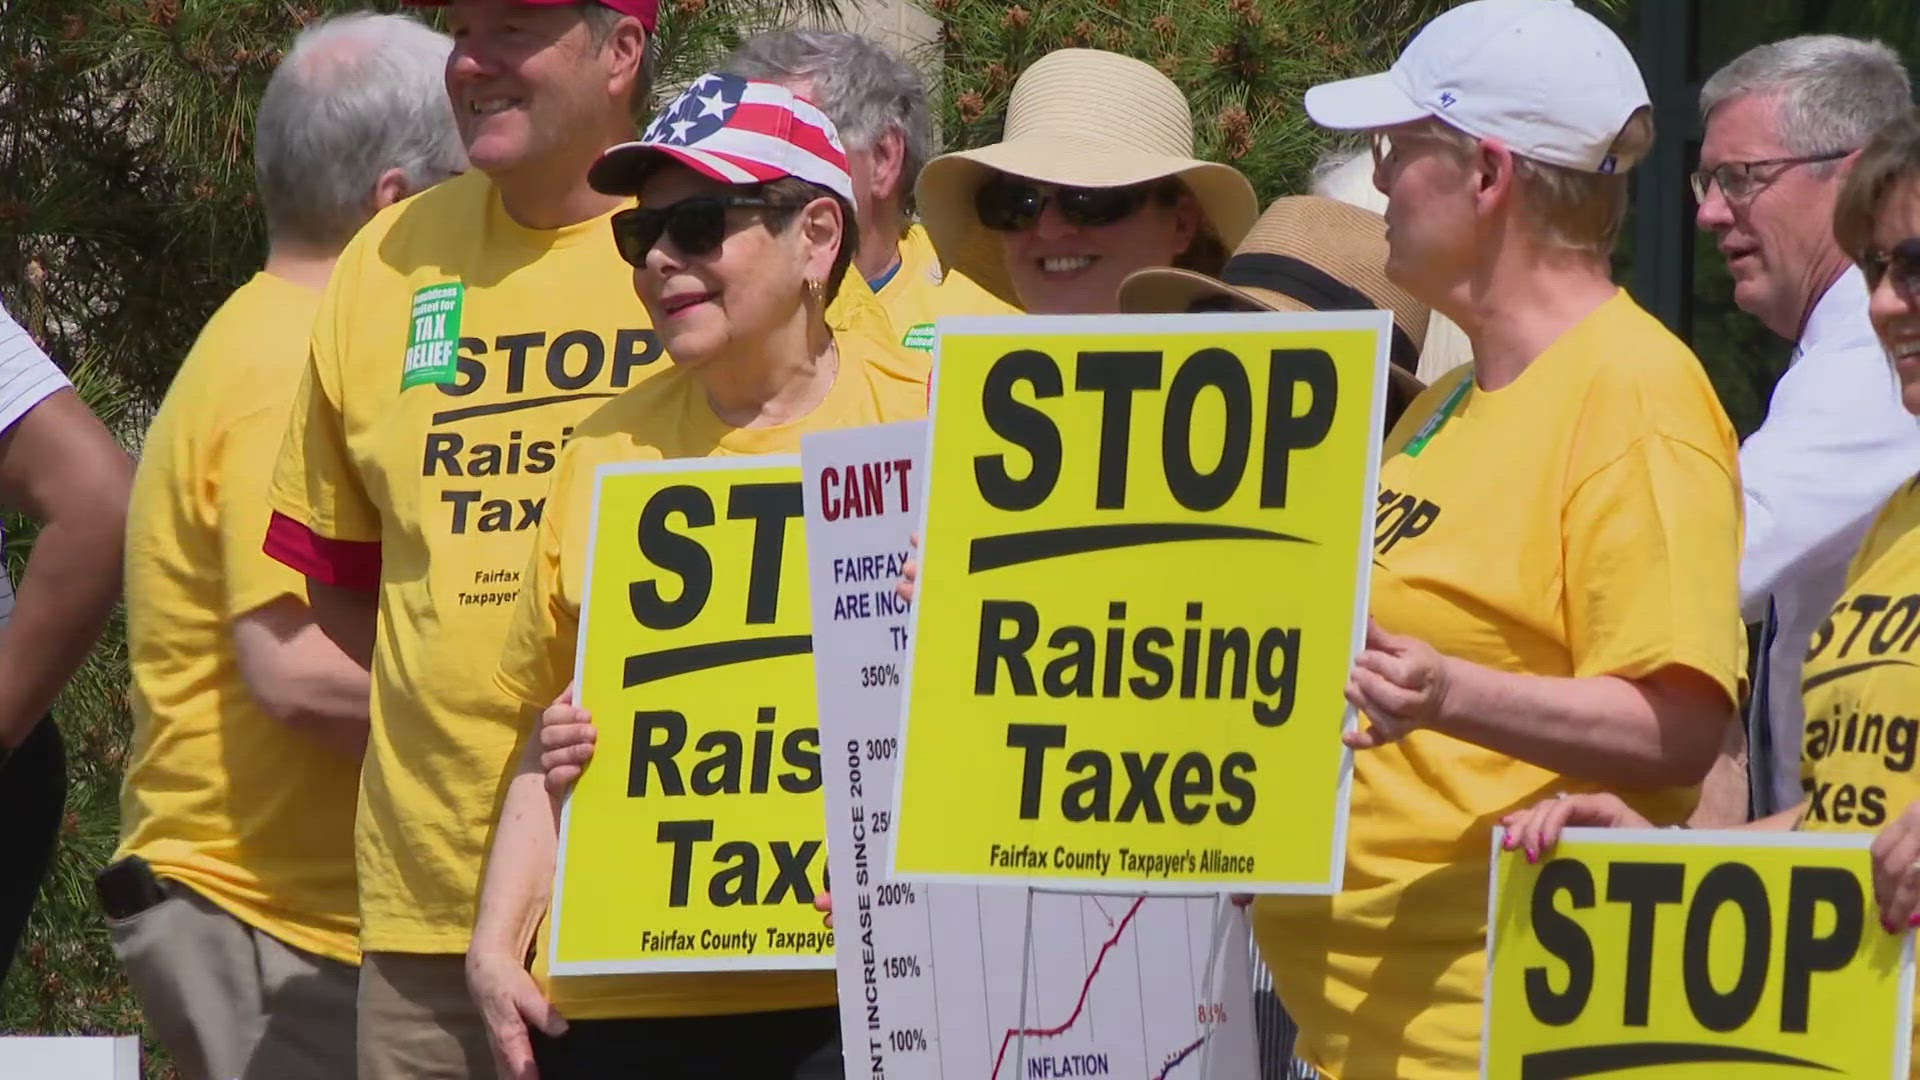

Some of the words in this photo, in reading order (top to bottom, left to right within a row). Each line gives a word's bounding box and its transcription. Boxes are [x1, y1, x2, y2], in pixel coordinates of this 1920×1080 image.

[415, 313, 446, 343] TAX
[404, 340, 453, 373] RELIEF
[436, 329, 664, 397] STOP
[974, 347, 1338, 512] STOP
[820, 459, 912, 522] CAN'T
[441, 490, 546, 534] Tax
[475, 569, 520, 584] Fairfax
[629, 484, 805, 631] ST
[834, 551, 909, 583] FAIRFAX
[834, 594, 871, 621] ARE
[875, 590, 911, 617] INC
[861, 663, 900, 687] 350%
[975, 600, 1301, 728] Raising
[626, 706, 823, 798] Rais
[847, 740, 862, 798] 2000
[1006, 724, 1258, 826] Taxes
[872, 809, 891, 834] 25
[656, 820, 831, 909] Tax
[852, 805, 868, 887] SINCE
[990, 844, 1048, 869] Fairfax
[1053, 846, 1111, 876] County
[1119, 847, 1196, 878] Taxpayer's
[1200, 849, 1255, 874] Alliance
[877, 882, 915, 906] 200%
[641, 930, 695, 952] Fairfax
[701, 929, 758, 954] County
[766, 927, 835, 953] Taxpaye
[1524, 857, 1864, 1034] STOP
[858, 893, 881, 1030] INCREASE
[883, 955, 921, 979] 150%
[889, 1028, 926, 1052] 100%
[1027, 1053, 1109, 1080] INFLATION
